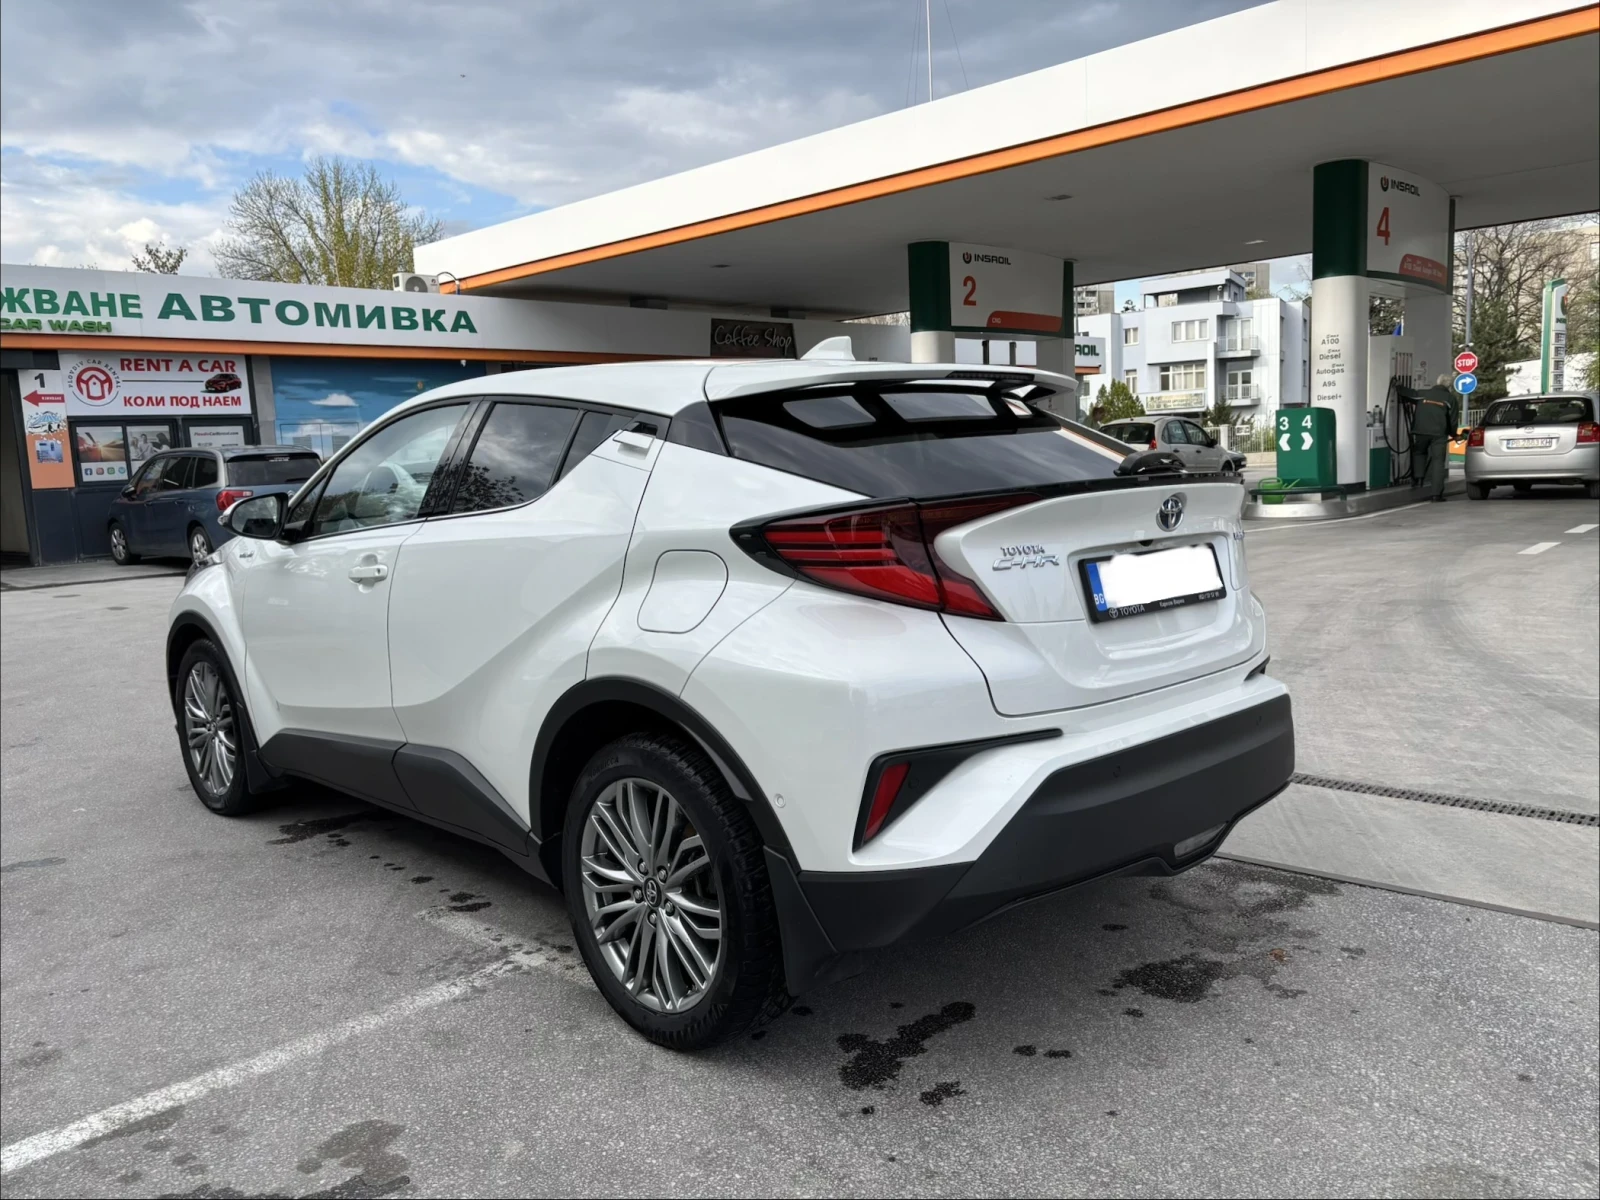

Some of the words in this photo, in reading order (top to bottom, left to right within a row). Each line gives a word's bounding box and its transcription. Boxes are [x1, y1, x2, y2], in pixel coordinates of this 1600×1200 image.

[1376, 207, 1391, 246] 4
[963, 275, 977, 307] 2
[157, 292, 478, 334] АВТОМИВКА
[48, 319, 112, 333] WASH
[714, 325, 760, 347] Coffee
[764, 327, 793, 357] Shop
[1319, 353, 1341, 361] Diesel
[1457, 359, 1475, 368] STOP
[120, 358, 173, 372] RENT
[178, 359, 193, 372] A
[197, 359, 237, 373] CAR
[34, 372, 46, 389] 1
[123, 396, 166, 407] КОЛИ
[170, 396, 200, 409] ПОД
[203, 396, 242, 407] НАЕМ
[1317, 393, 1343, 401] Diesel+
[1279, 416, 1290, 431] 3
[1301, 415, 1313, 429] 4
[1000, 544, 1046, 557] TOYOTA
[992, 554, 1060, 571] C-HR
[1093, 593, 1105, 605] BG
[1120, 603, 1146, 616] TOYOTA
